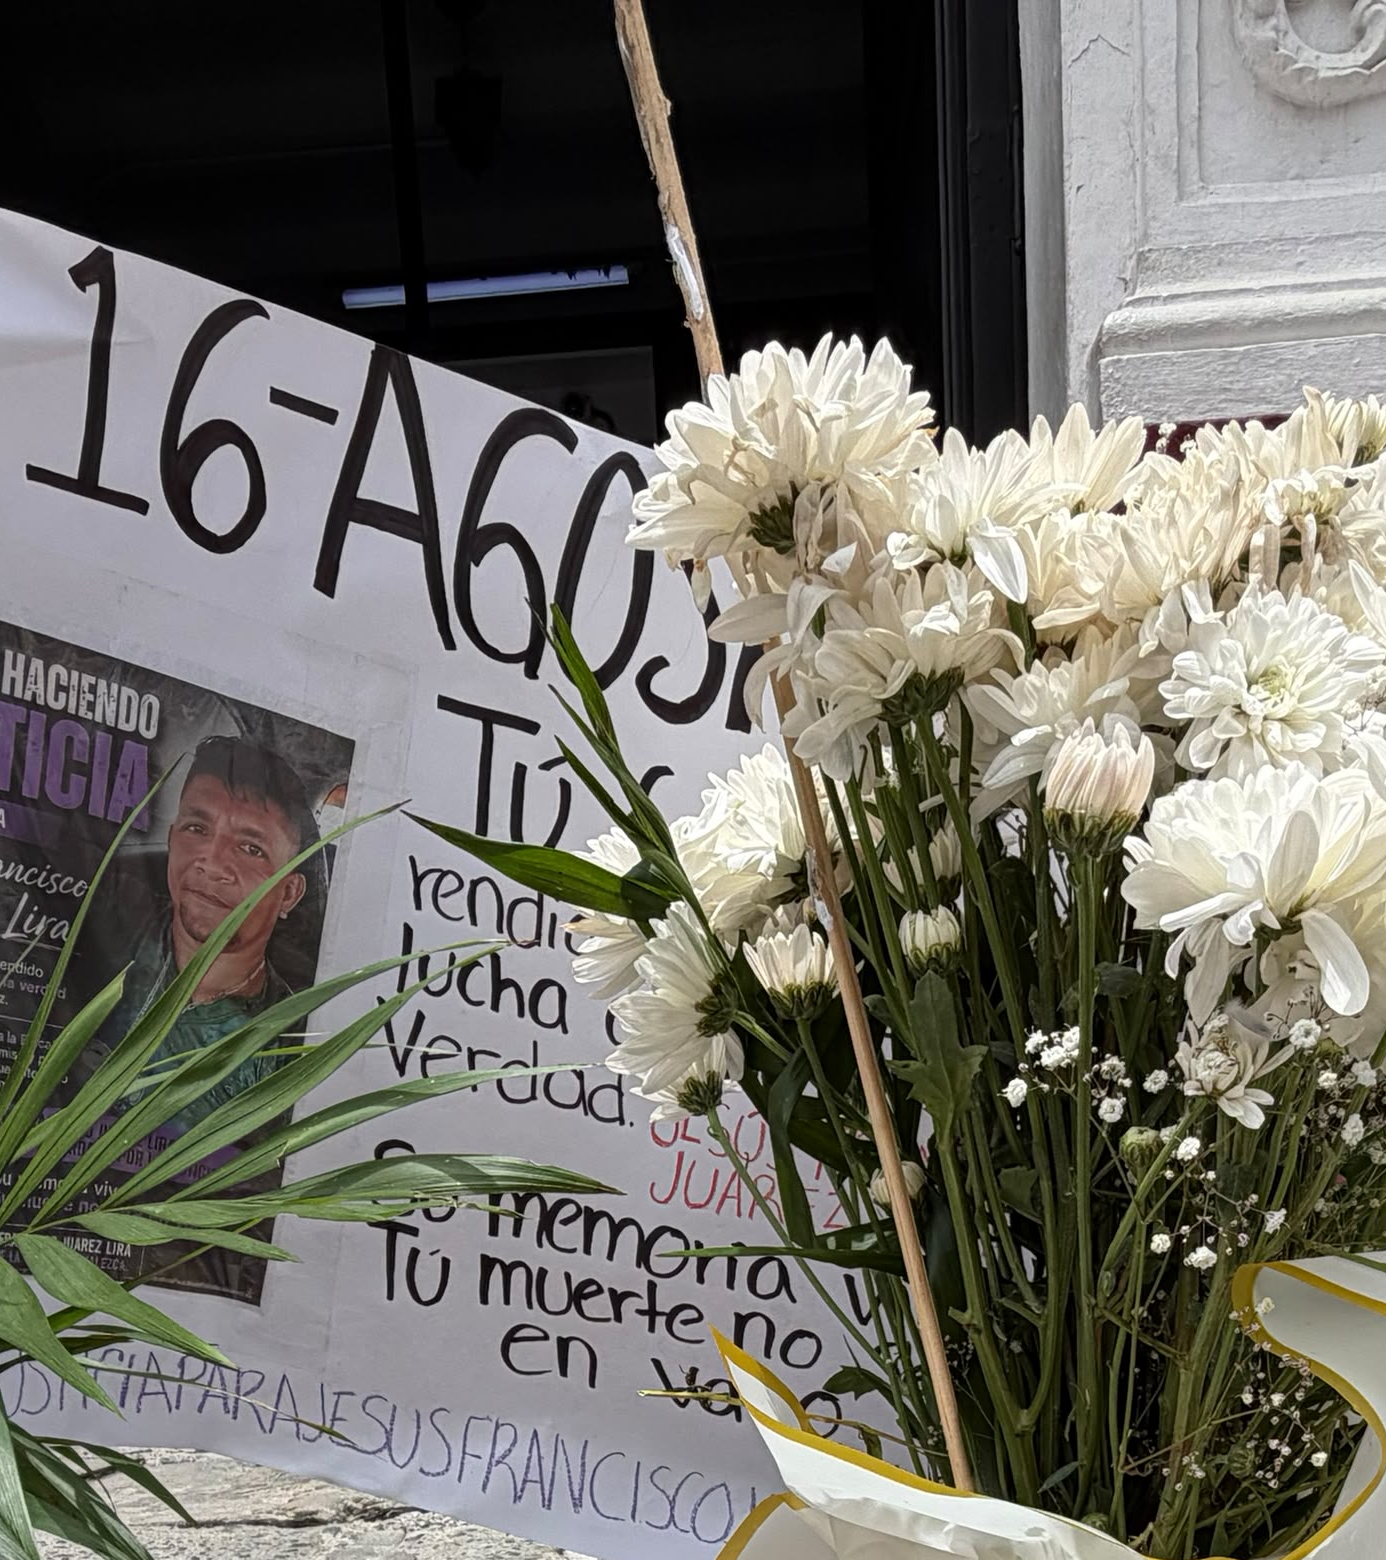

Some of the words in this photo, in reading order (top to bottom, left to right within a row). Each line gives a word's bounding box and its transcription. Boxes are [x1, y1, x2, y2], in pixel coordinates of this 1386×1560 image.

[1, 648, 161, 740] HACIENDO
[1, 892, 70, 942] Lira
[19, 981, 67, 1000] verd
[397, 922, 569, 1036] lucha
[7, 1030, 17, 1045] la
[378, 996, 635, 1128] Verdad.
[94, 1180, 119, 1197] viv
[649, 1150, 847, 1230] JUARZ
[105, 1240, 132, 1258] LIRA
[487, 1192, 797, 1303] memoria
[366, 1219, 452, 1307] Tú
[479, 1252, 706, 1344] muerte
[733, 1310, 822, 1370] no
[500, 1323, 597, 1389] en
[650, 1357, 842, 1439] vao
